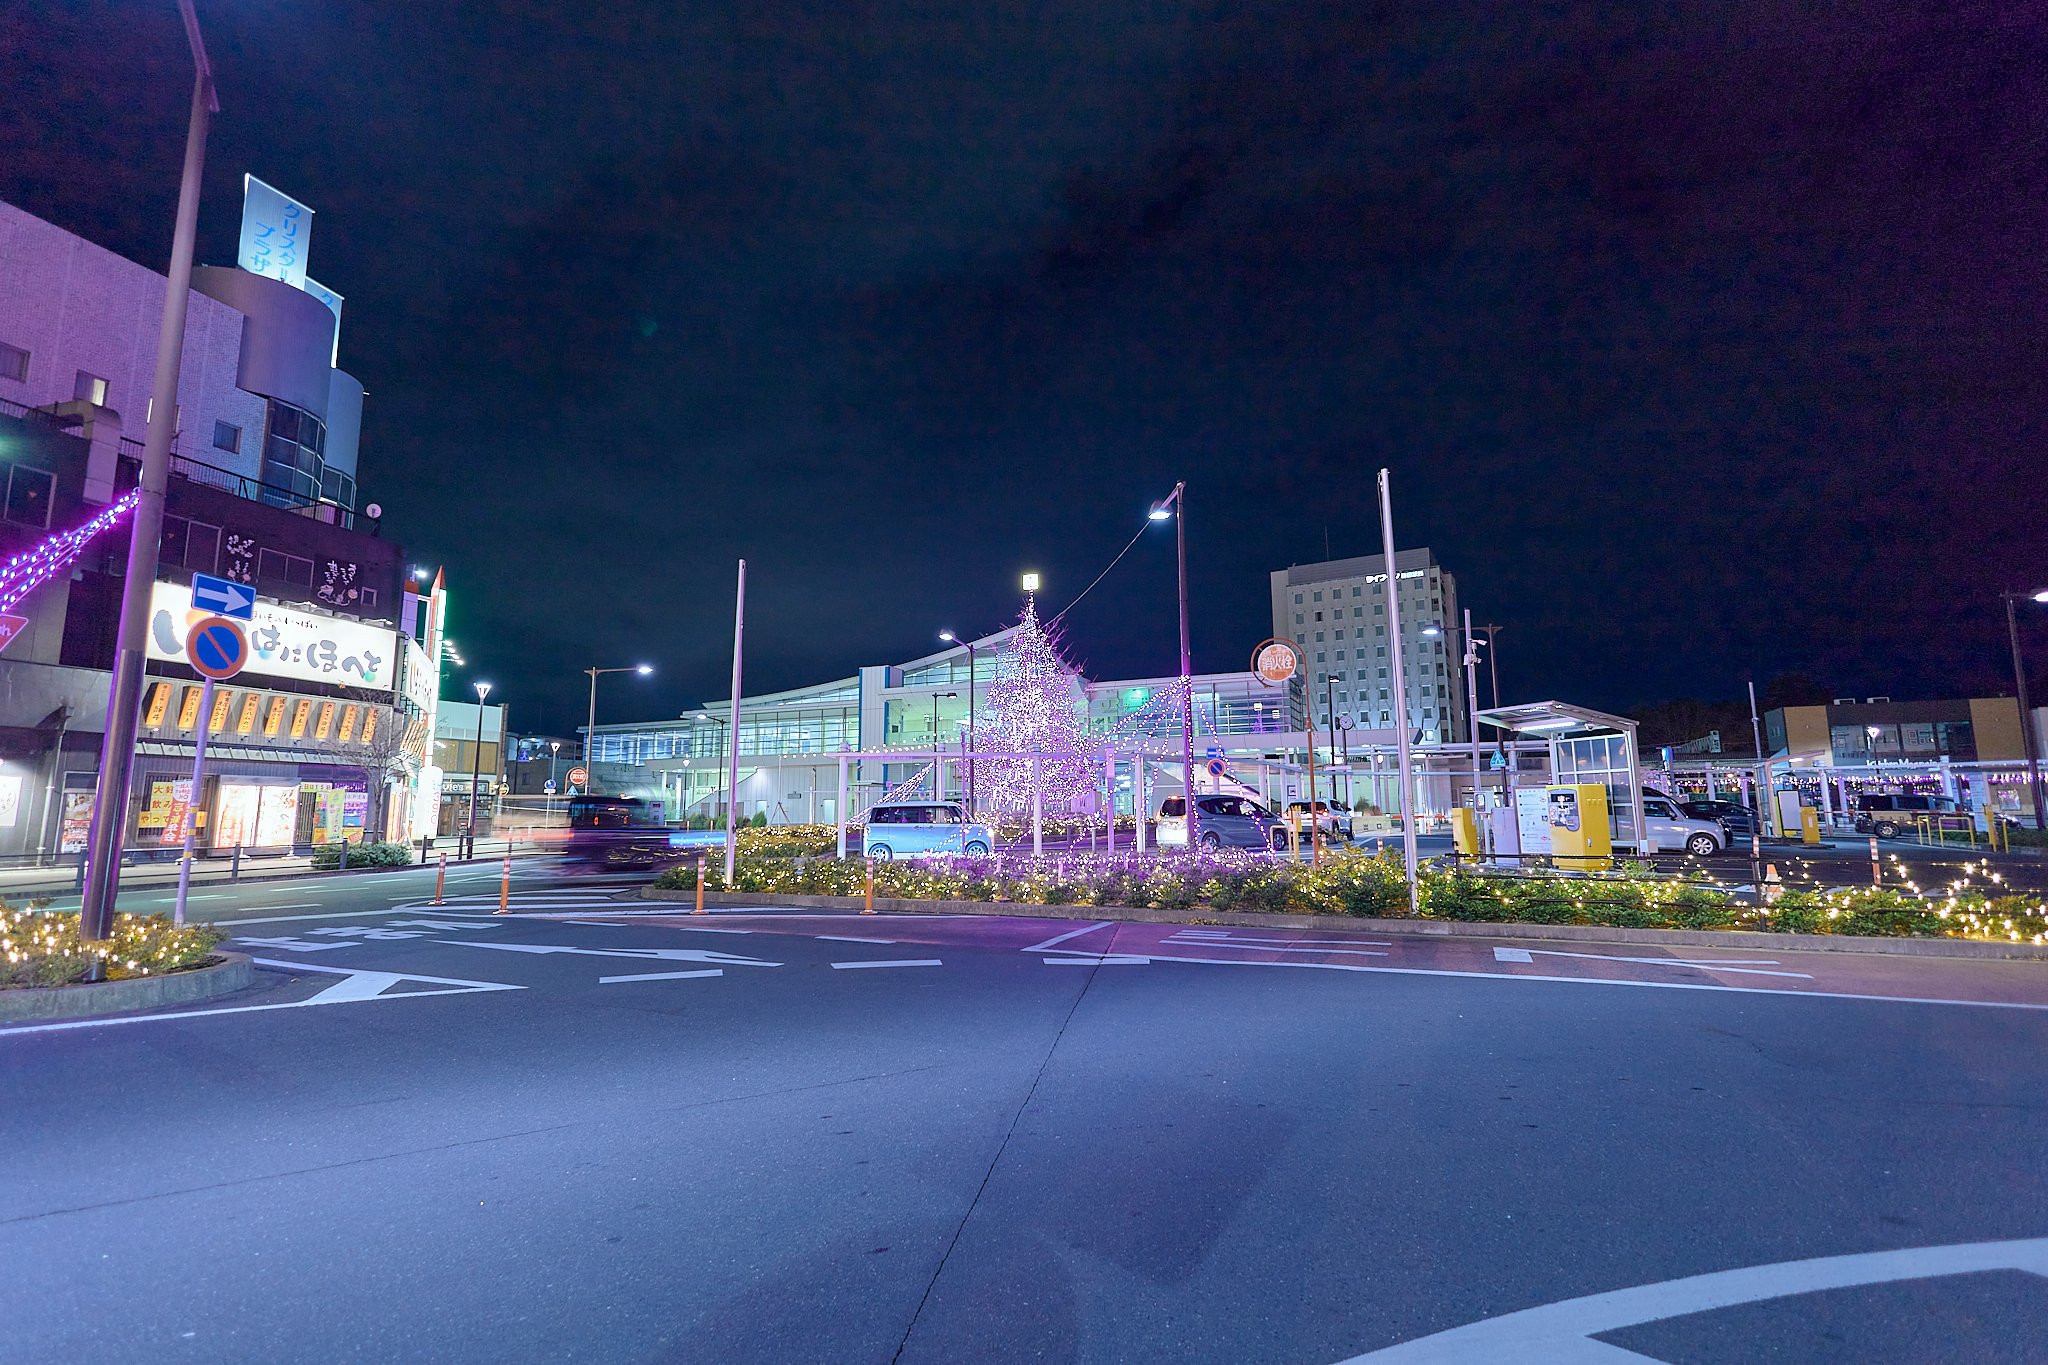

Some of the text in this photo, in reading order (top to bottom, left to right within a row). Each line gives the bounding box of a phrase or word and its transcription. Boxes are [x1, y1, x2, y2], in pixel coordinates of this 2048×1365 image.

[250, 221, 276, 272] プラザ
[279, 203, 301, 284] クリスタル
[1261, 654, 1293, 671] 消火栓
[1099, 697, 1120, 710] JR
